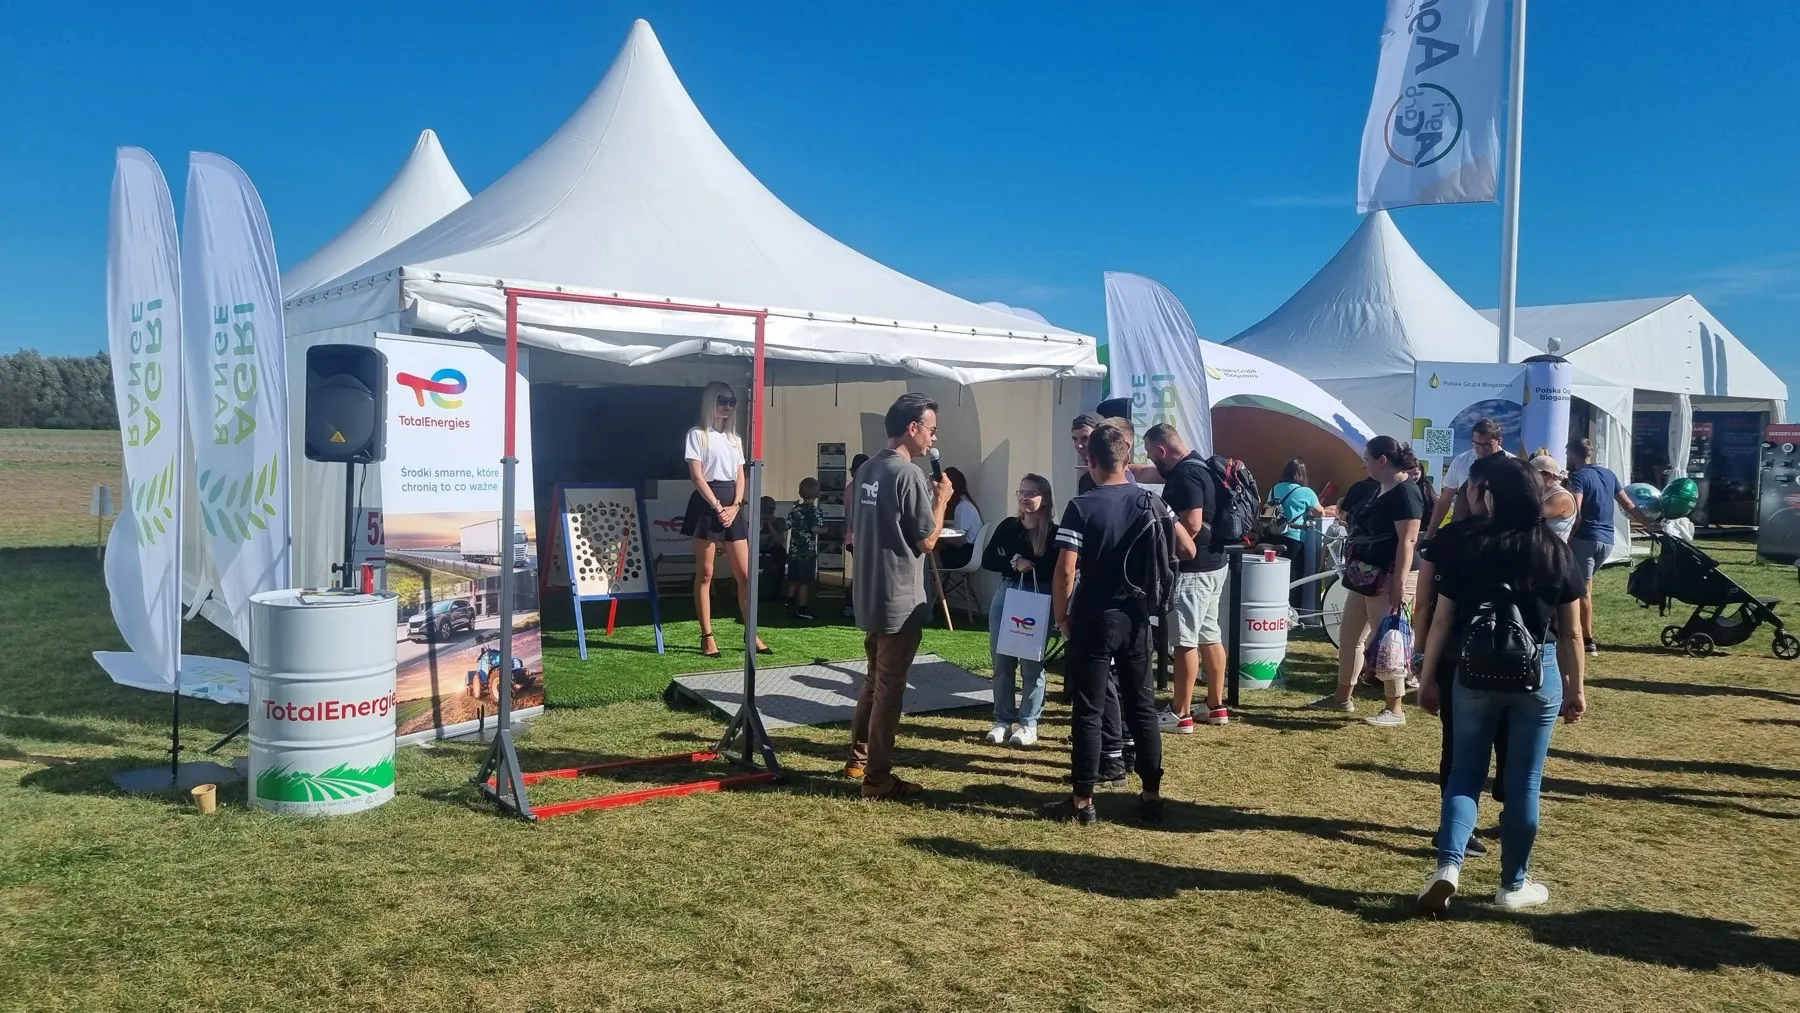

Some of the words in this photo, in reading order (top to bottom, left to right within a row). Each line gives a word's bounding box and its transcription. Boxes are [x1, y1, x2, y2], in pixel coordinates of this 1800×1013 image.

[398, 415, 470, 430] TotalEnergies
[400, 465, 432, 478] Środki
[434, 468, 474, 479] smarne,
[476, 467, 499, 478] które
[401, 482, 438, 493] chronią
[440, 483, 451, 492] to
[454, 483, 467, 492] co
[469, 482, 498, 491] ważne
